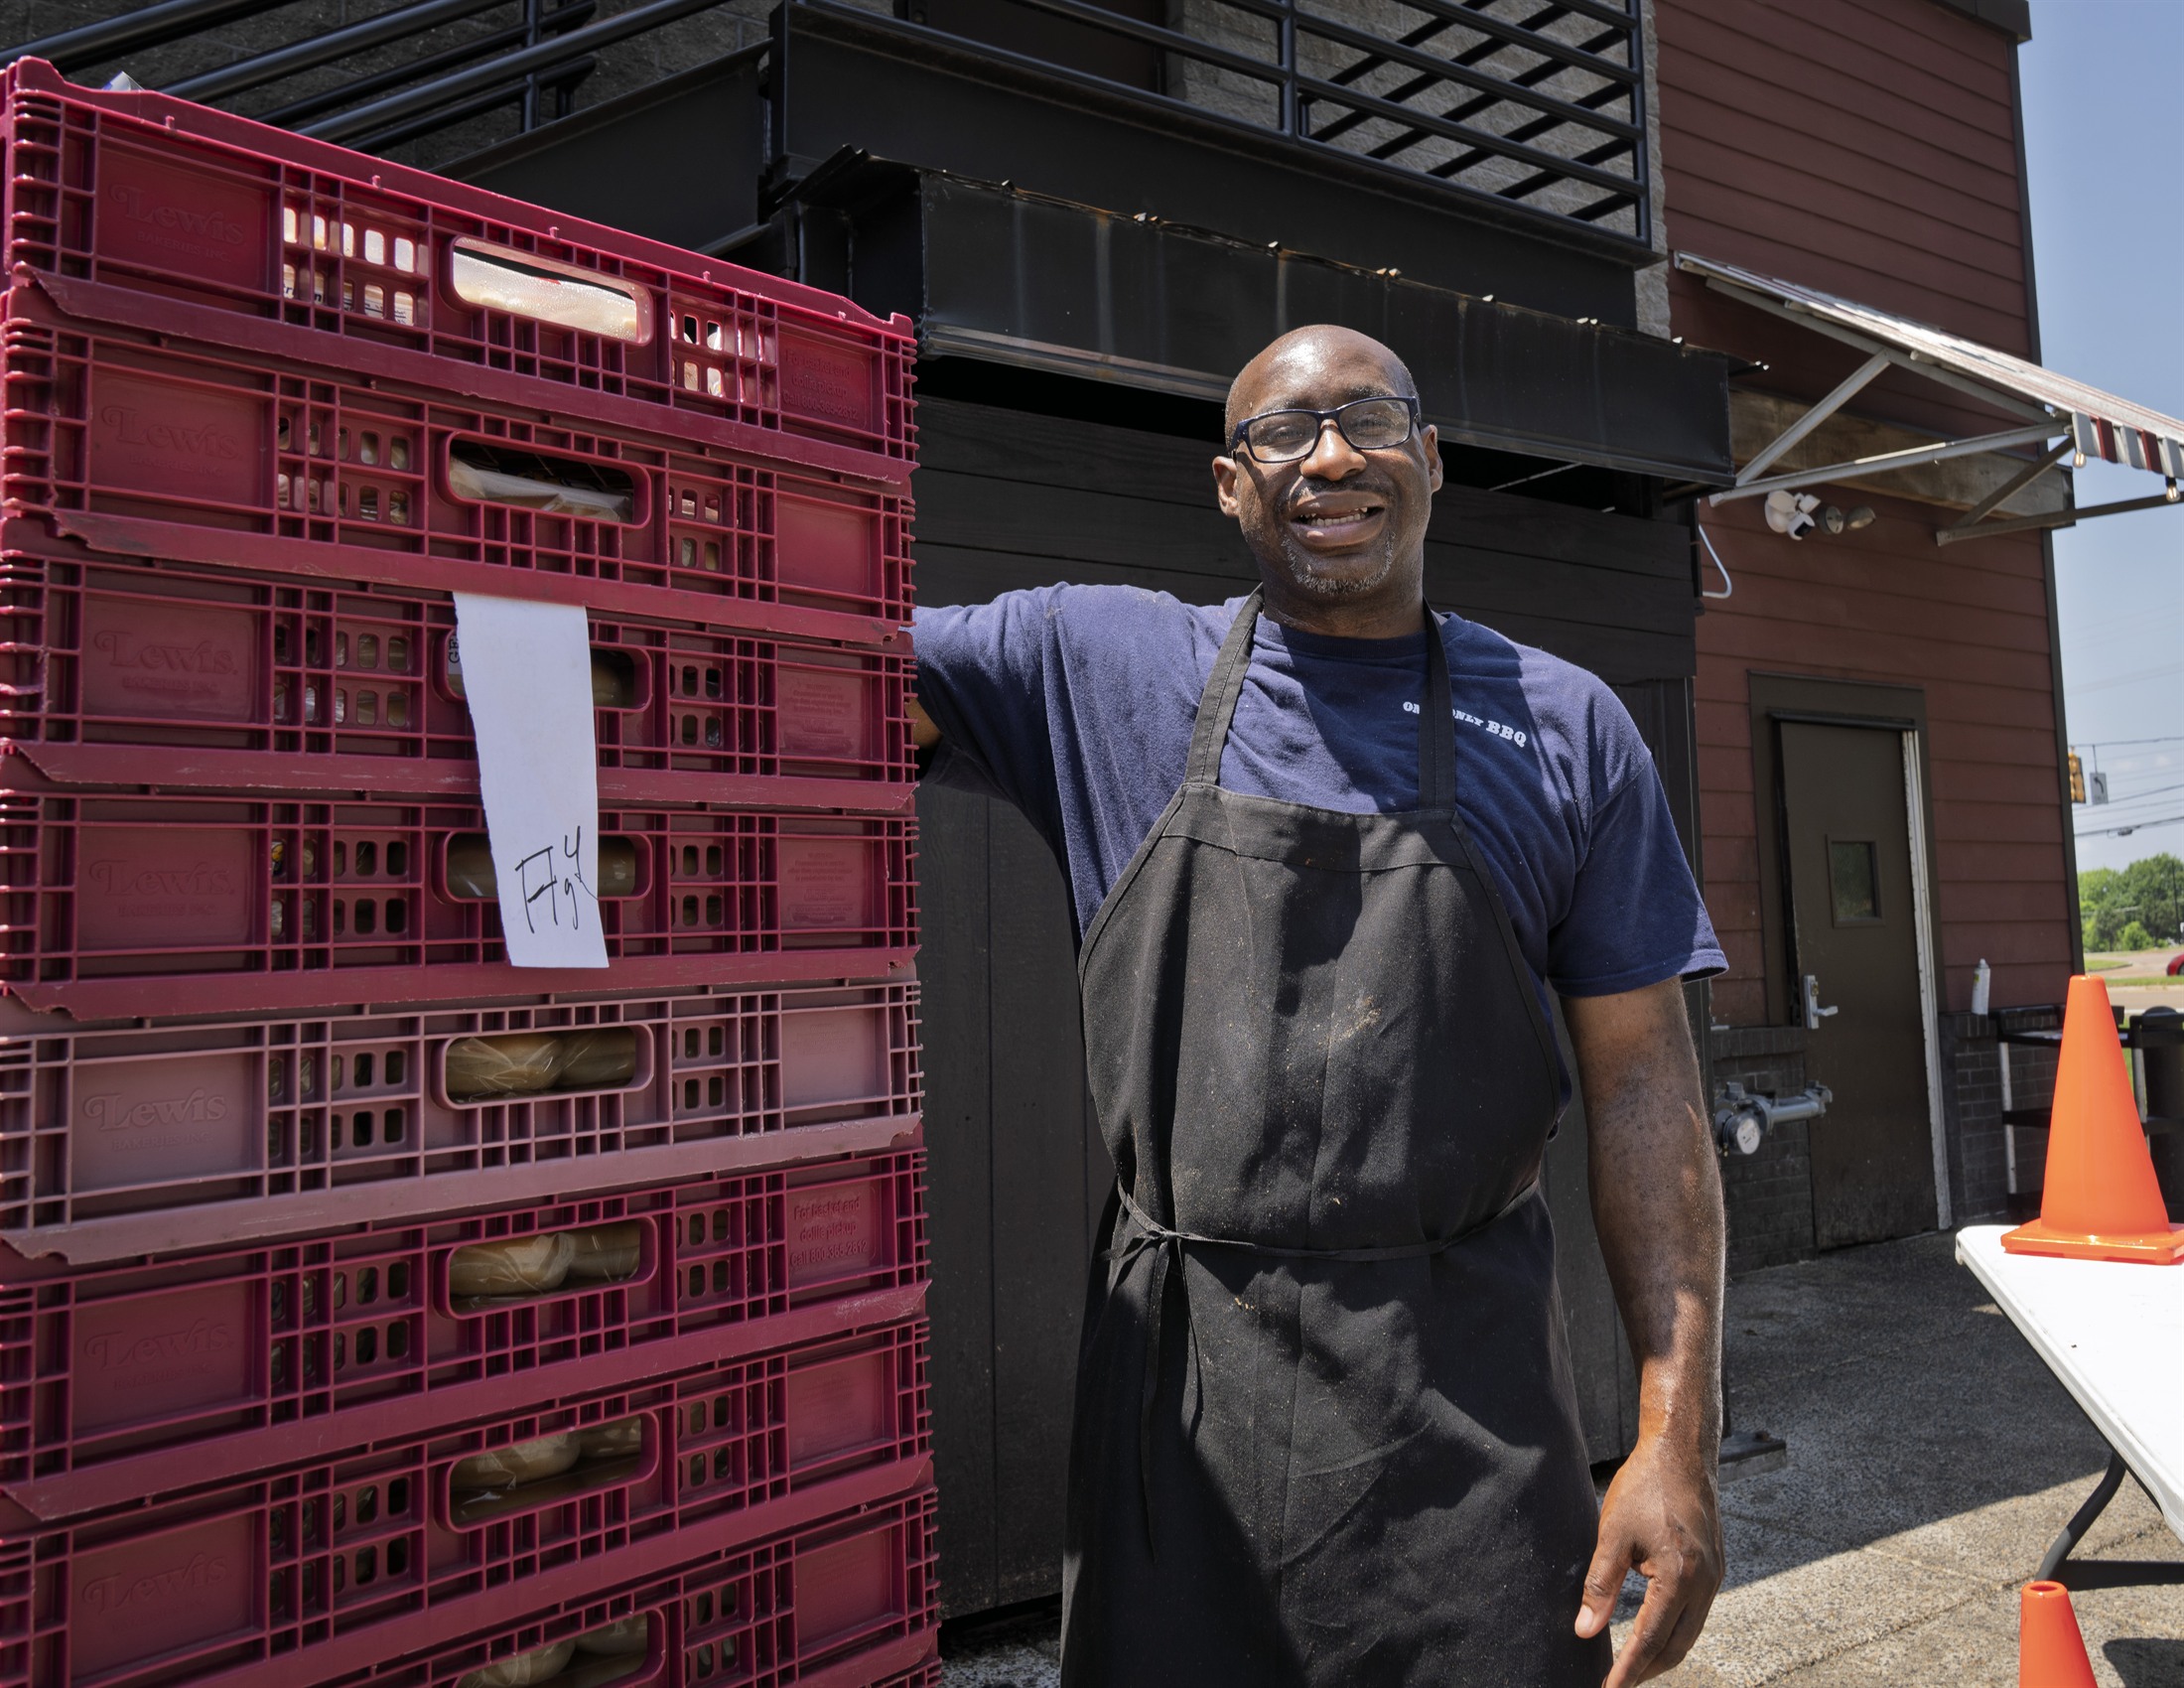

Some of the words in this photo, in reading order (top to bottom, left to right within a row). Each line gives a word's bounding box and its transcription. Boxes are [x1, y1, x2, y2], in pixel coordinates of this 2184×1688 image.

[108, 183, 246, 246] Lewis
[135, 229, 201, 255] BAKERIES
[785, 349, 802, 365] For
[782, 388, 800, 407] Call
[100, 404, 239, 460] Lewis
[93, 629, 235, 675] Lewis
[1451, 709, 1484, 727] NLY
[1485, 720, 1527, 749] BBQ
[88, 859, 232, 897] Lewis
[82, 1086, 227, 1132] Lewis
[112, 1134, 183, 1152] BAKERIES
[794, 1202, 810, 1220] For
[811, 1199, 842, 1217] basket
[843, 1196, 861, 1212] and
[800, 1224, 826, 1242] dollie
[826, 1220, 858, 1239] pickup
[790, 1249, 809, 1266] Call
[809, 1239, 868, 1263] 800-365-2812
[83, 1317, 231, 1371] Lewis
[81, 1549, 227, 1617] Lewis
